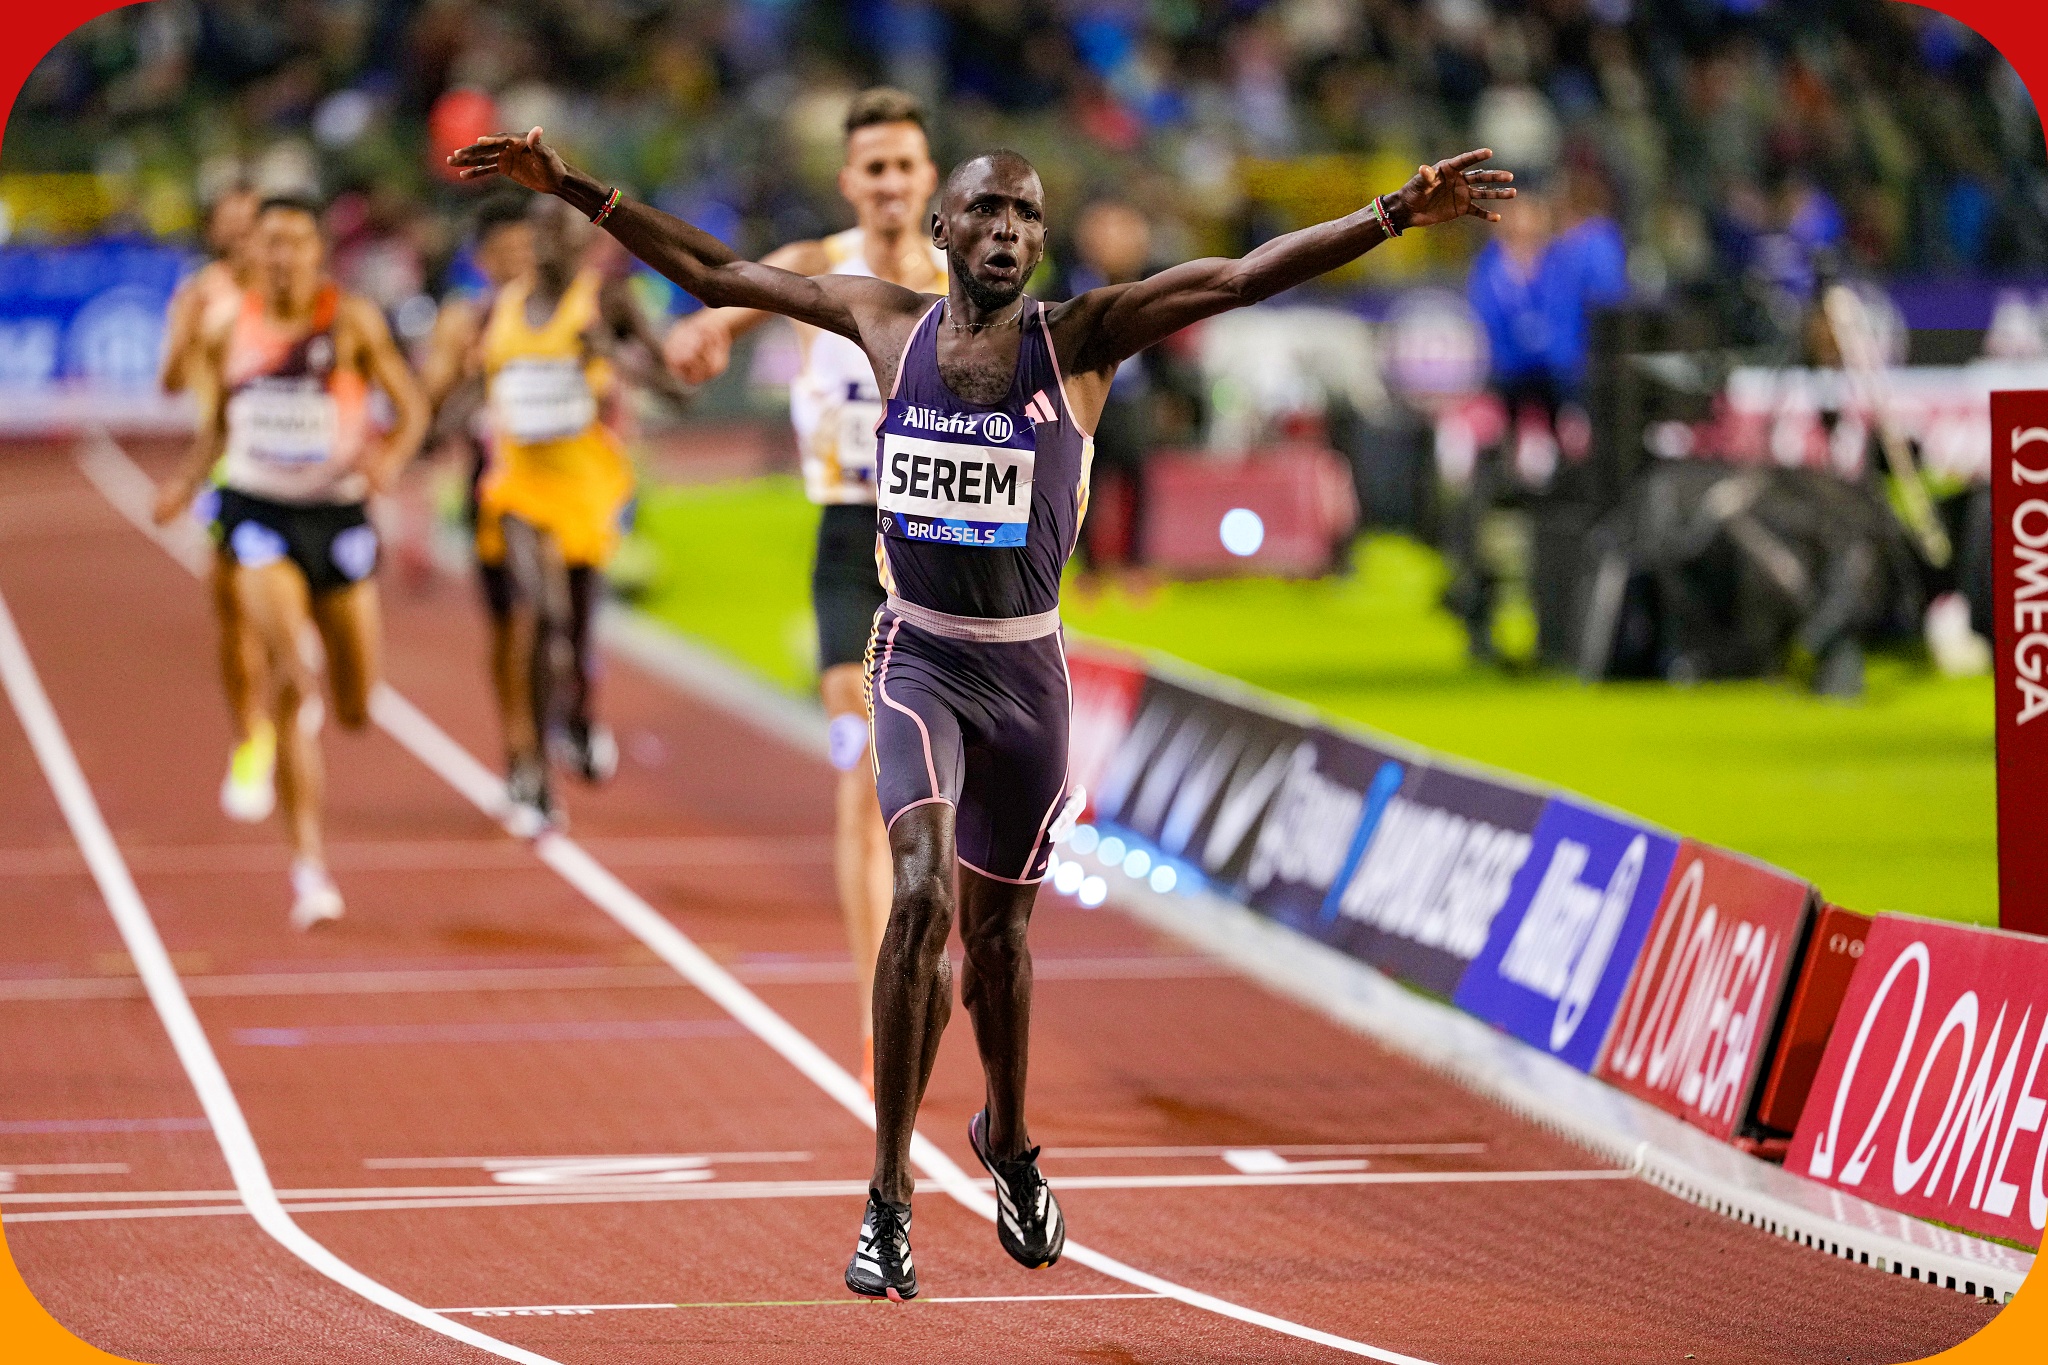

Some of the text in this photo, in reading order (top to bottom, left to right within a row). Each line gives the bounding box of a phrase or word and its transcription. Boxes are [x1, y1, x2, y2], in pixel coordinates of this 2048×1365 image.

[902, 405, 978, 436] Allianz
[888, 452, 1019, 507] SEREM
[906, 520, 996, 545] BRUSSELS
[2012, 498, 2048, 726] OMEGA
[1645, 903, 1782, 1125] OMEGA
